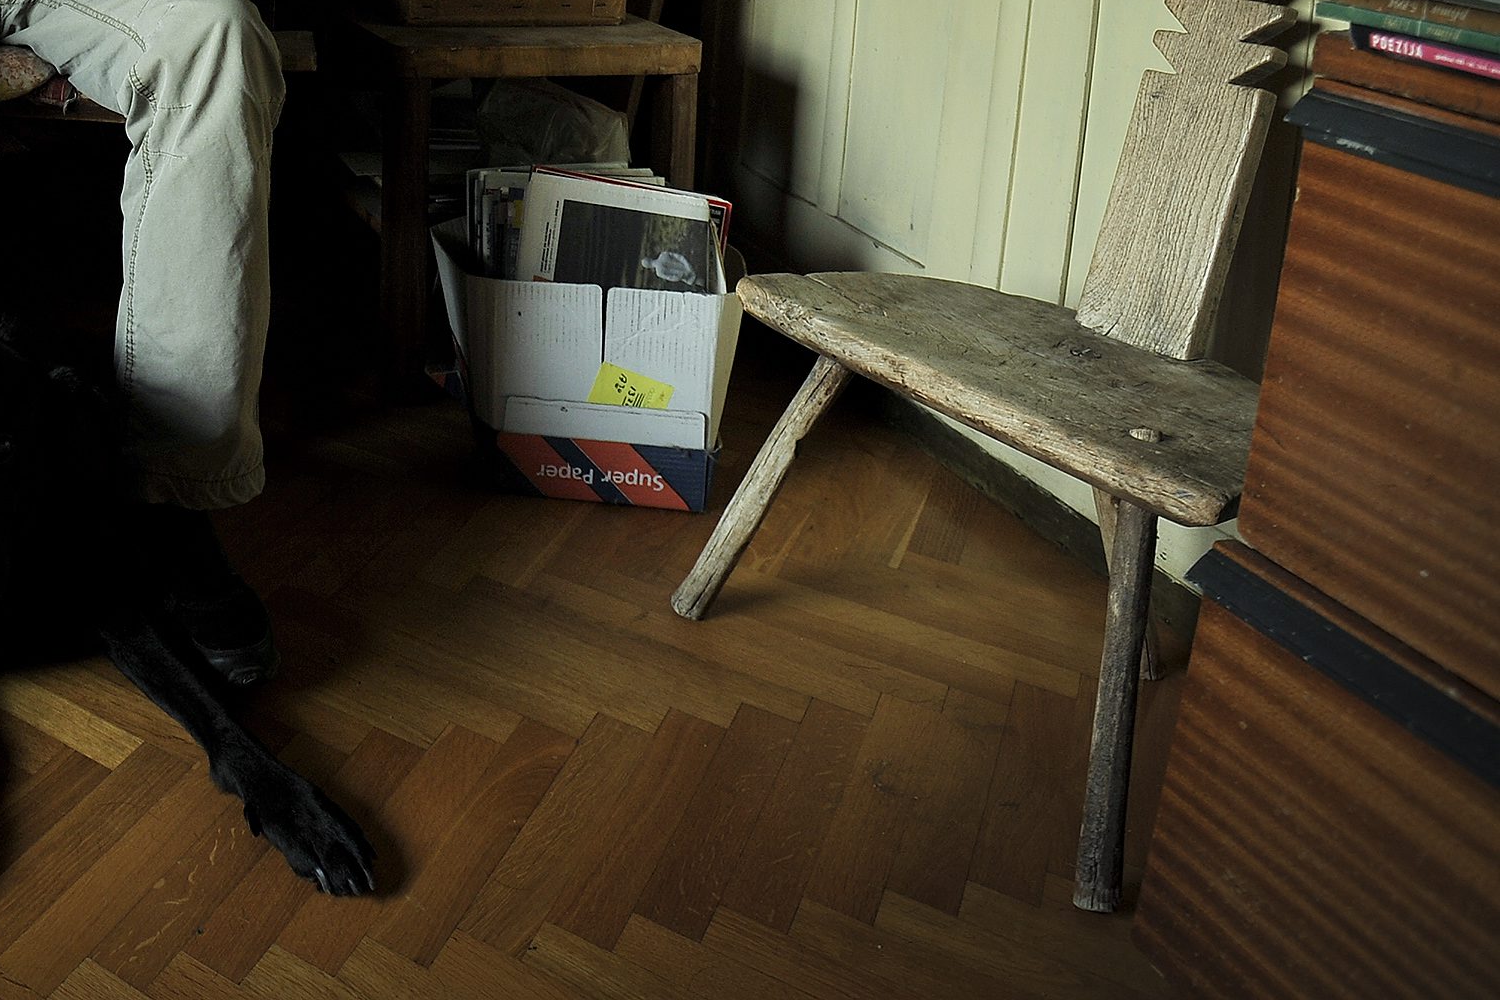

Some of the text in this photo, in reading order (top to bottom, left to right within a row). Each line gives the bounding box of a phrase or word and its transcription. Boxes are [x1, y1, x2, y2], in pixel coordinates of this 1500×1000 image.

[1371, 32, 1424, 59] POEZIJA
[535, 462, 665, 492] Super Paper
